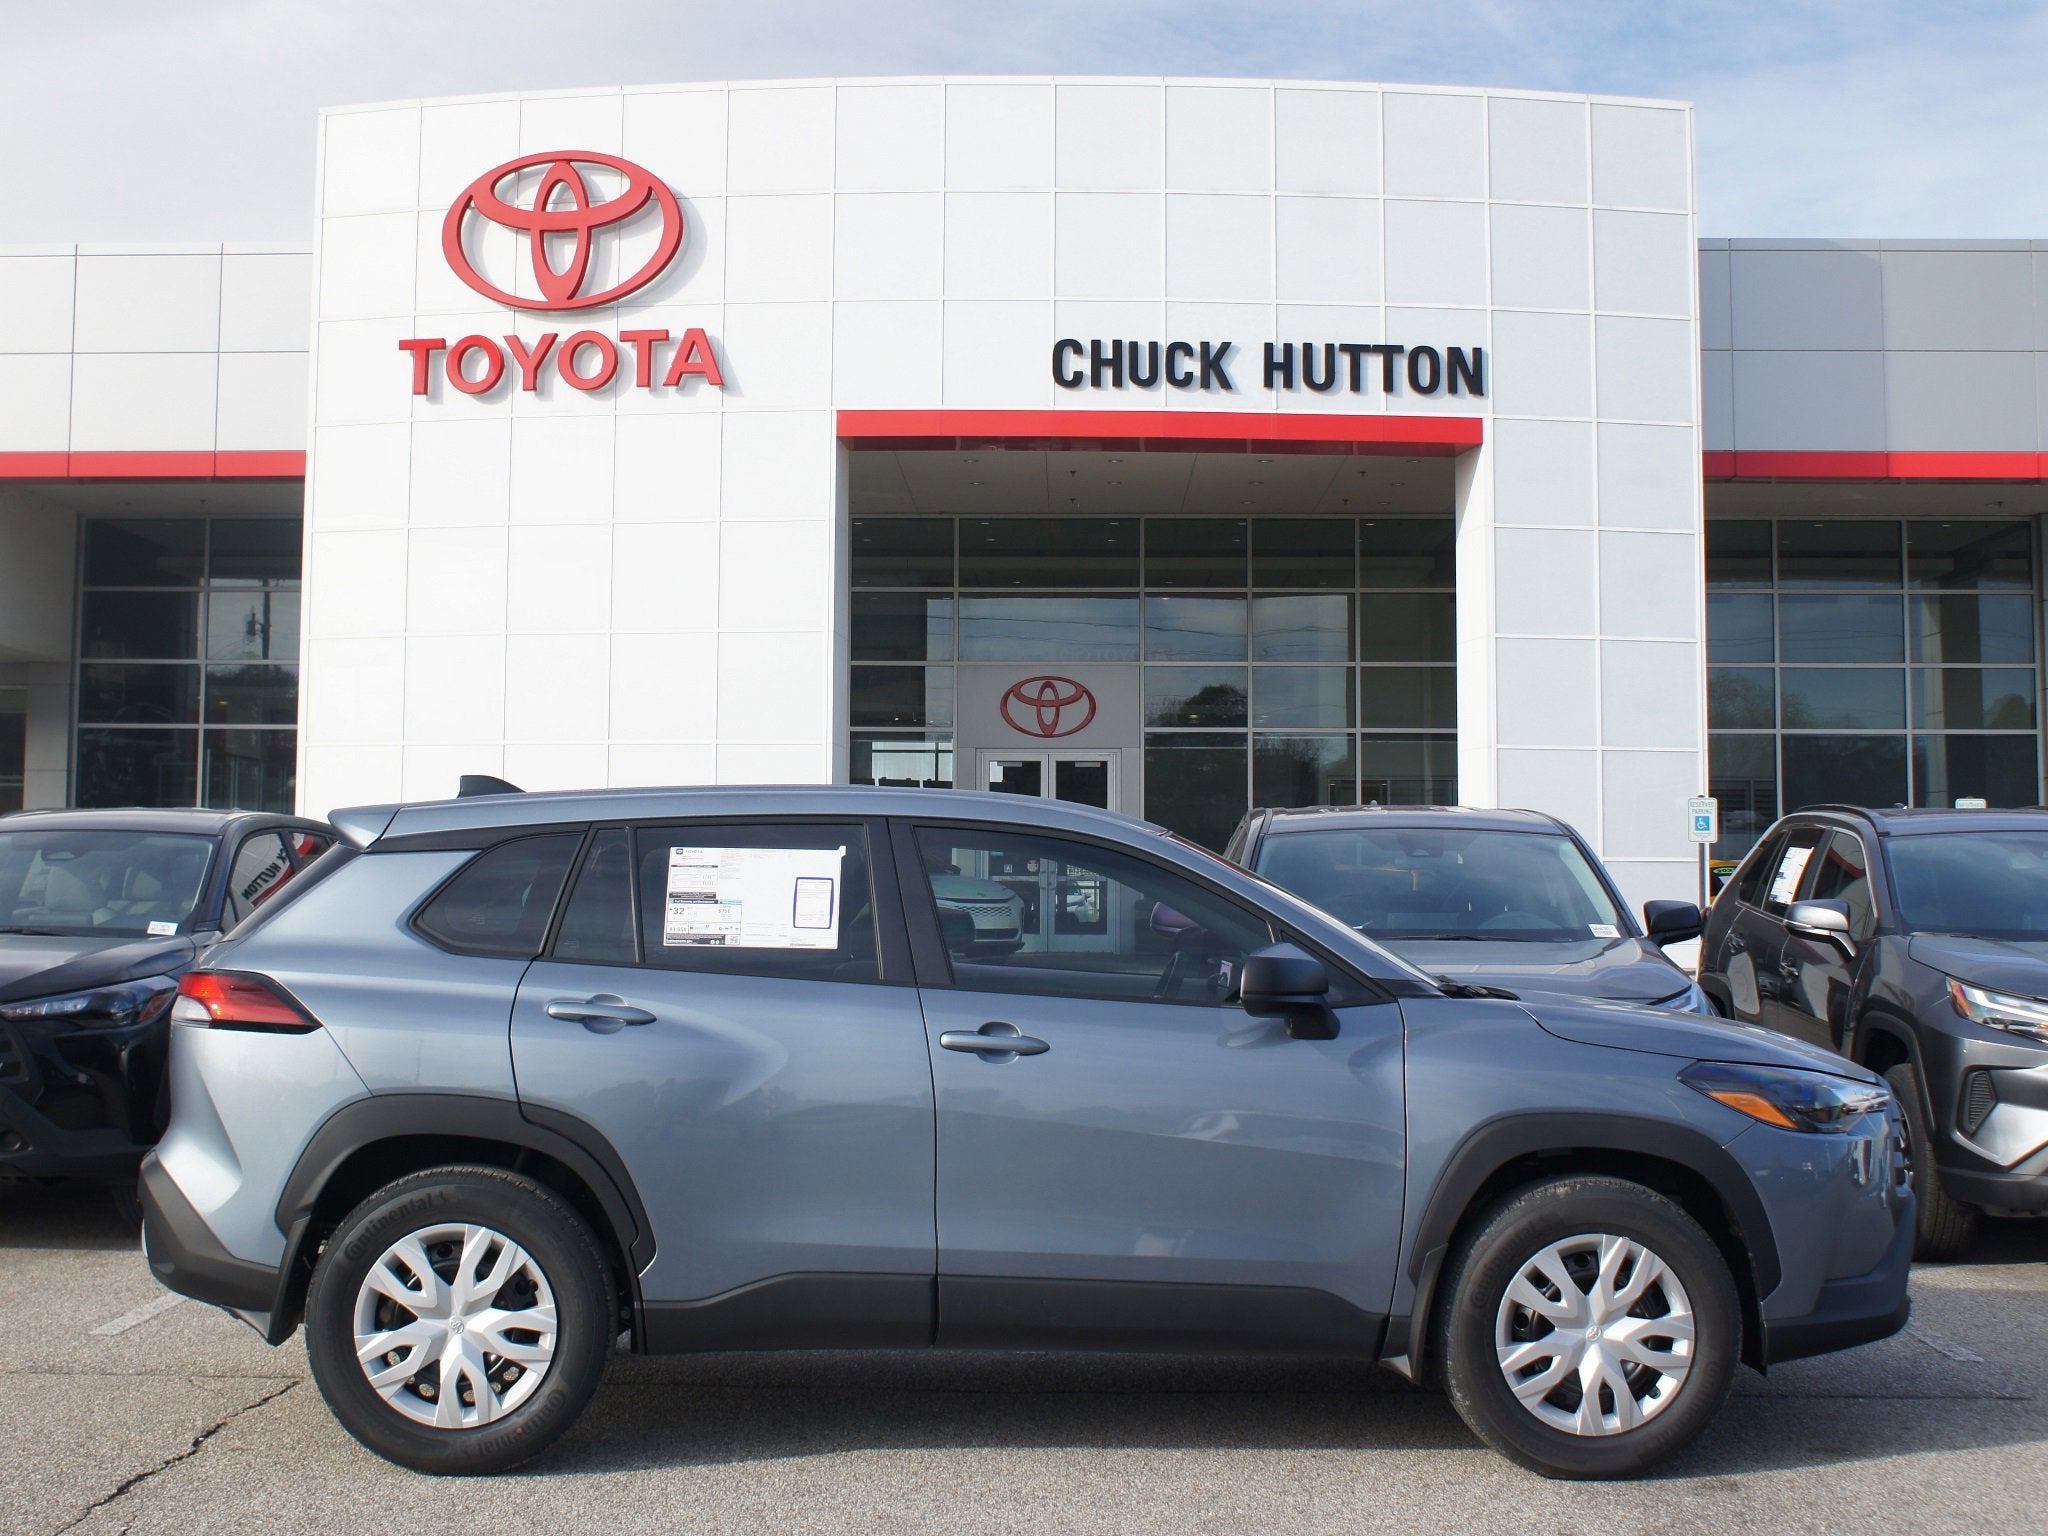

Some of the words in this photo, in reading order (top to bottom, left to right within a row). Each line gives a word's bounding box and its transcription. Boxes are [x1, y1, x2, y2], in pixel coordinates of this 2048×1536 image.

[398, 327, 725, 396] TOYOTA
[1052, 338, 1235, 390] CHUCK
[1262, 342, 1486, 397] HUTTON
[672, 907, 685, 915] 32
[345, 1192, 433, 1262] Continental
